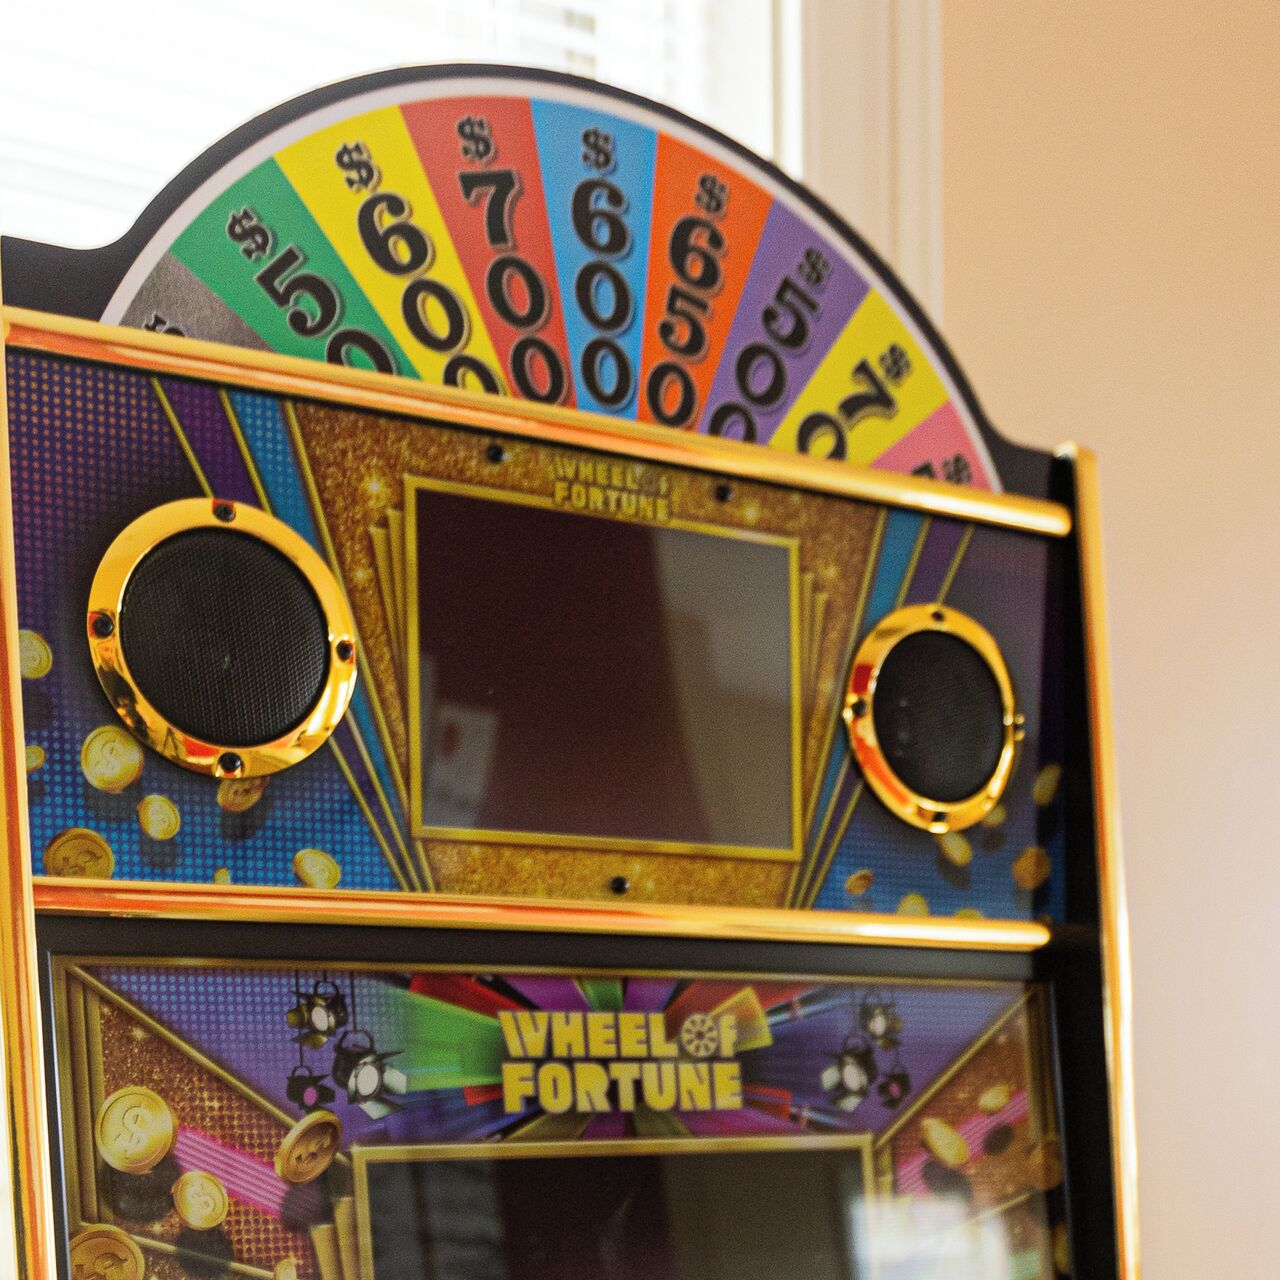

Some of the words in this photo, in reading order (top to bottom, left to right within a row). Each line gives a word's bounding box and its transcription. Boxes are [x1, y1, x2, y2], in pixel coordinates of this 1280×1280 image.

[570, 126, 634, 409] $600
[645, 173, 728, 428] $650
[554, 480, 670, 521] FORTUNE
[498, 1010, 678, 1058] WHEEL
[501, 1060, 743, 1114] FORTUNE
